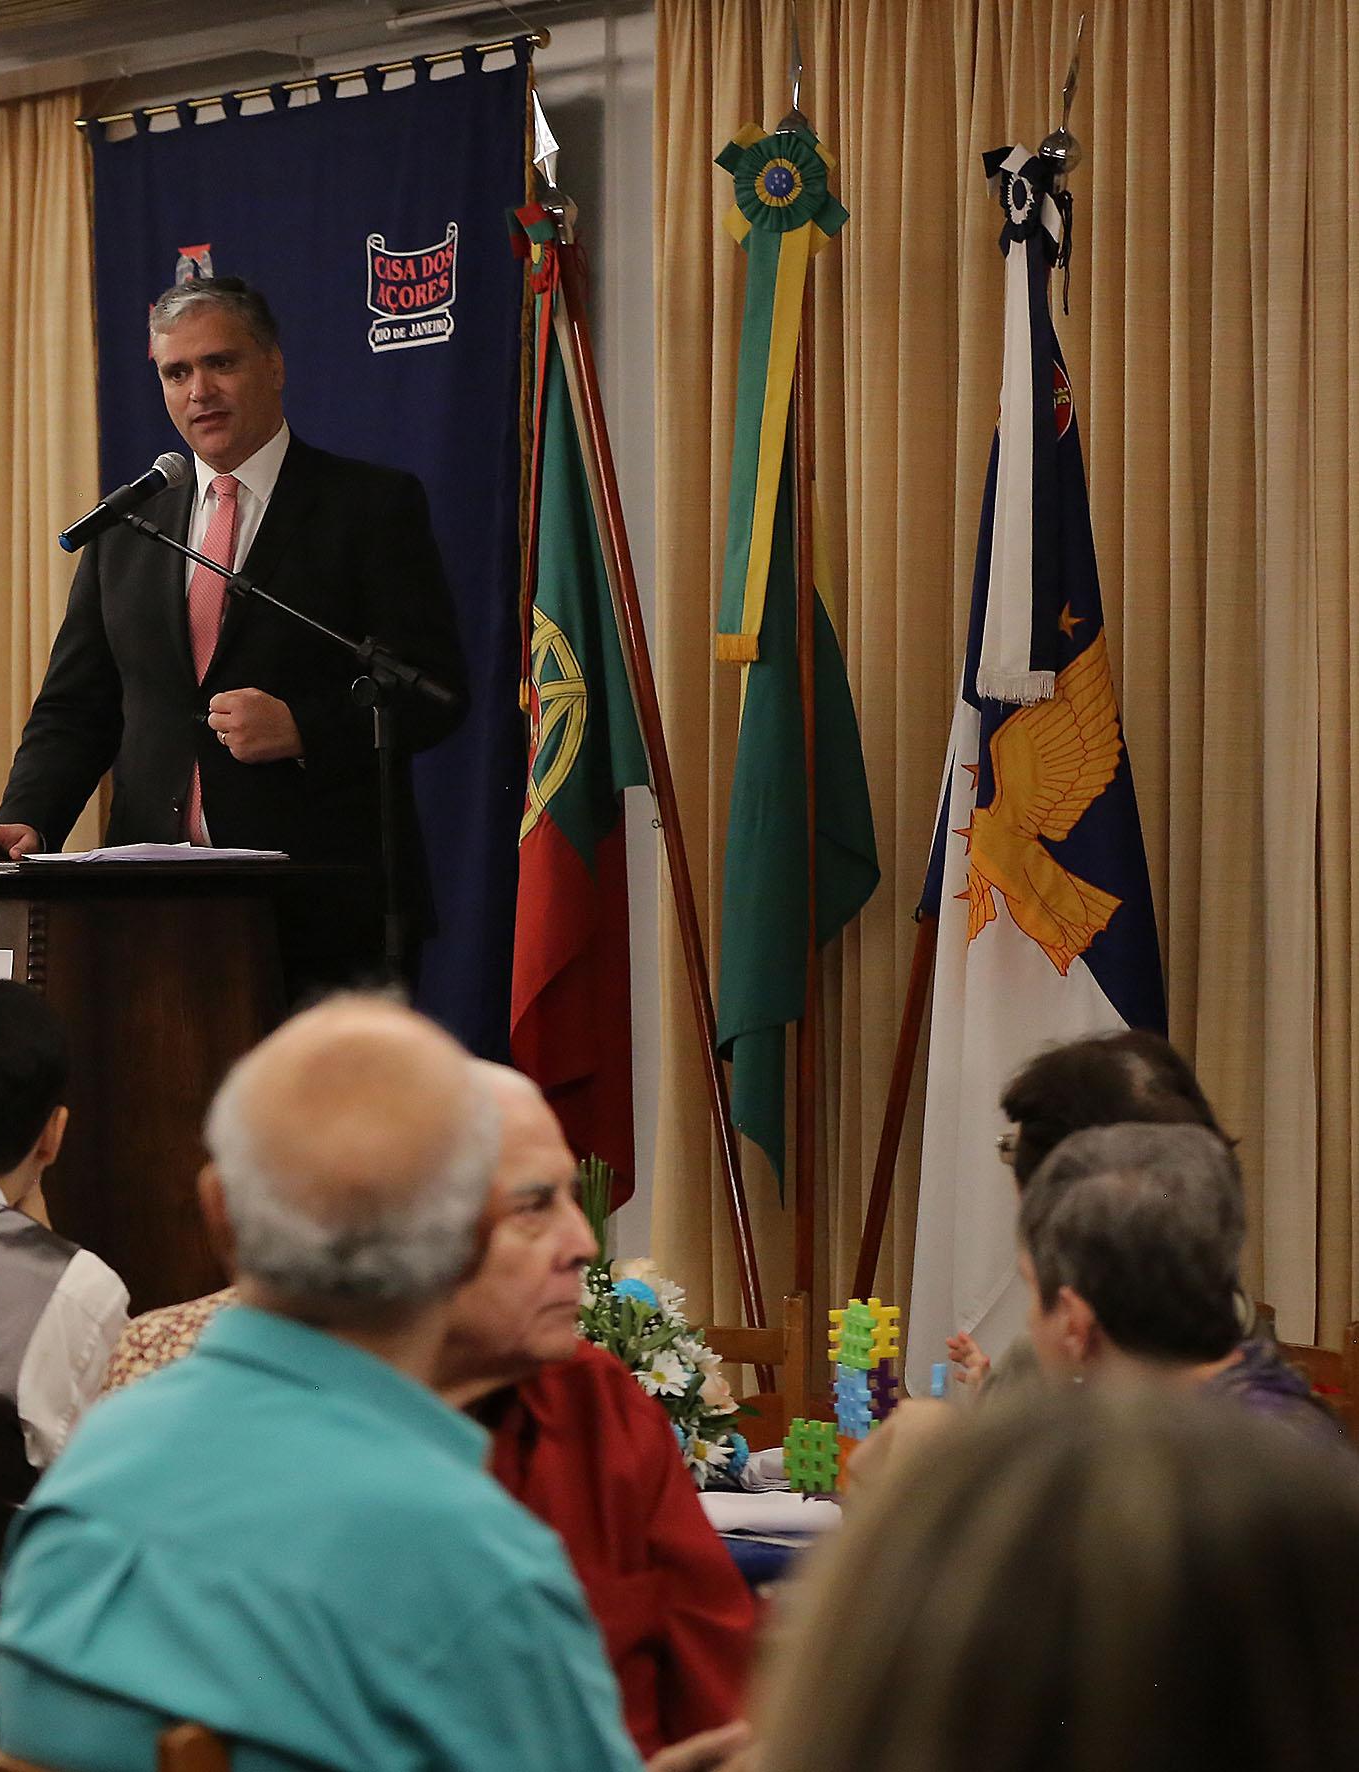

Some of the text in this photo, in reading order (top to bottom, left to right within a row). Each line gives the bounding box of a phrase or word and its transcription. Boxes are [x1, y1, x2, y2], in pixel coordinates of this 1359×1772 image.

[421, 244, 453, 277] DOS
[376, 272, 449, 315] AÇORES
[374, 319, 448, 342] RIO DE JANEIRO
